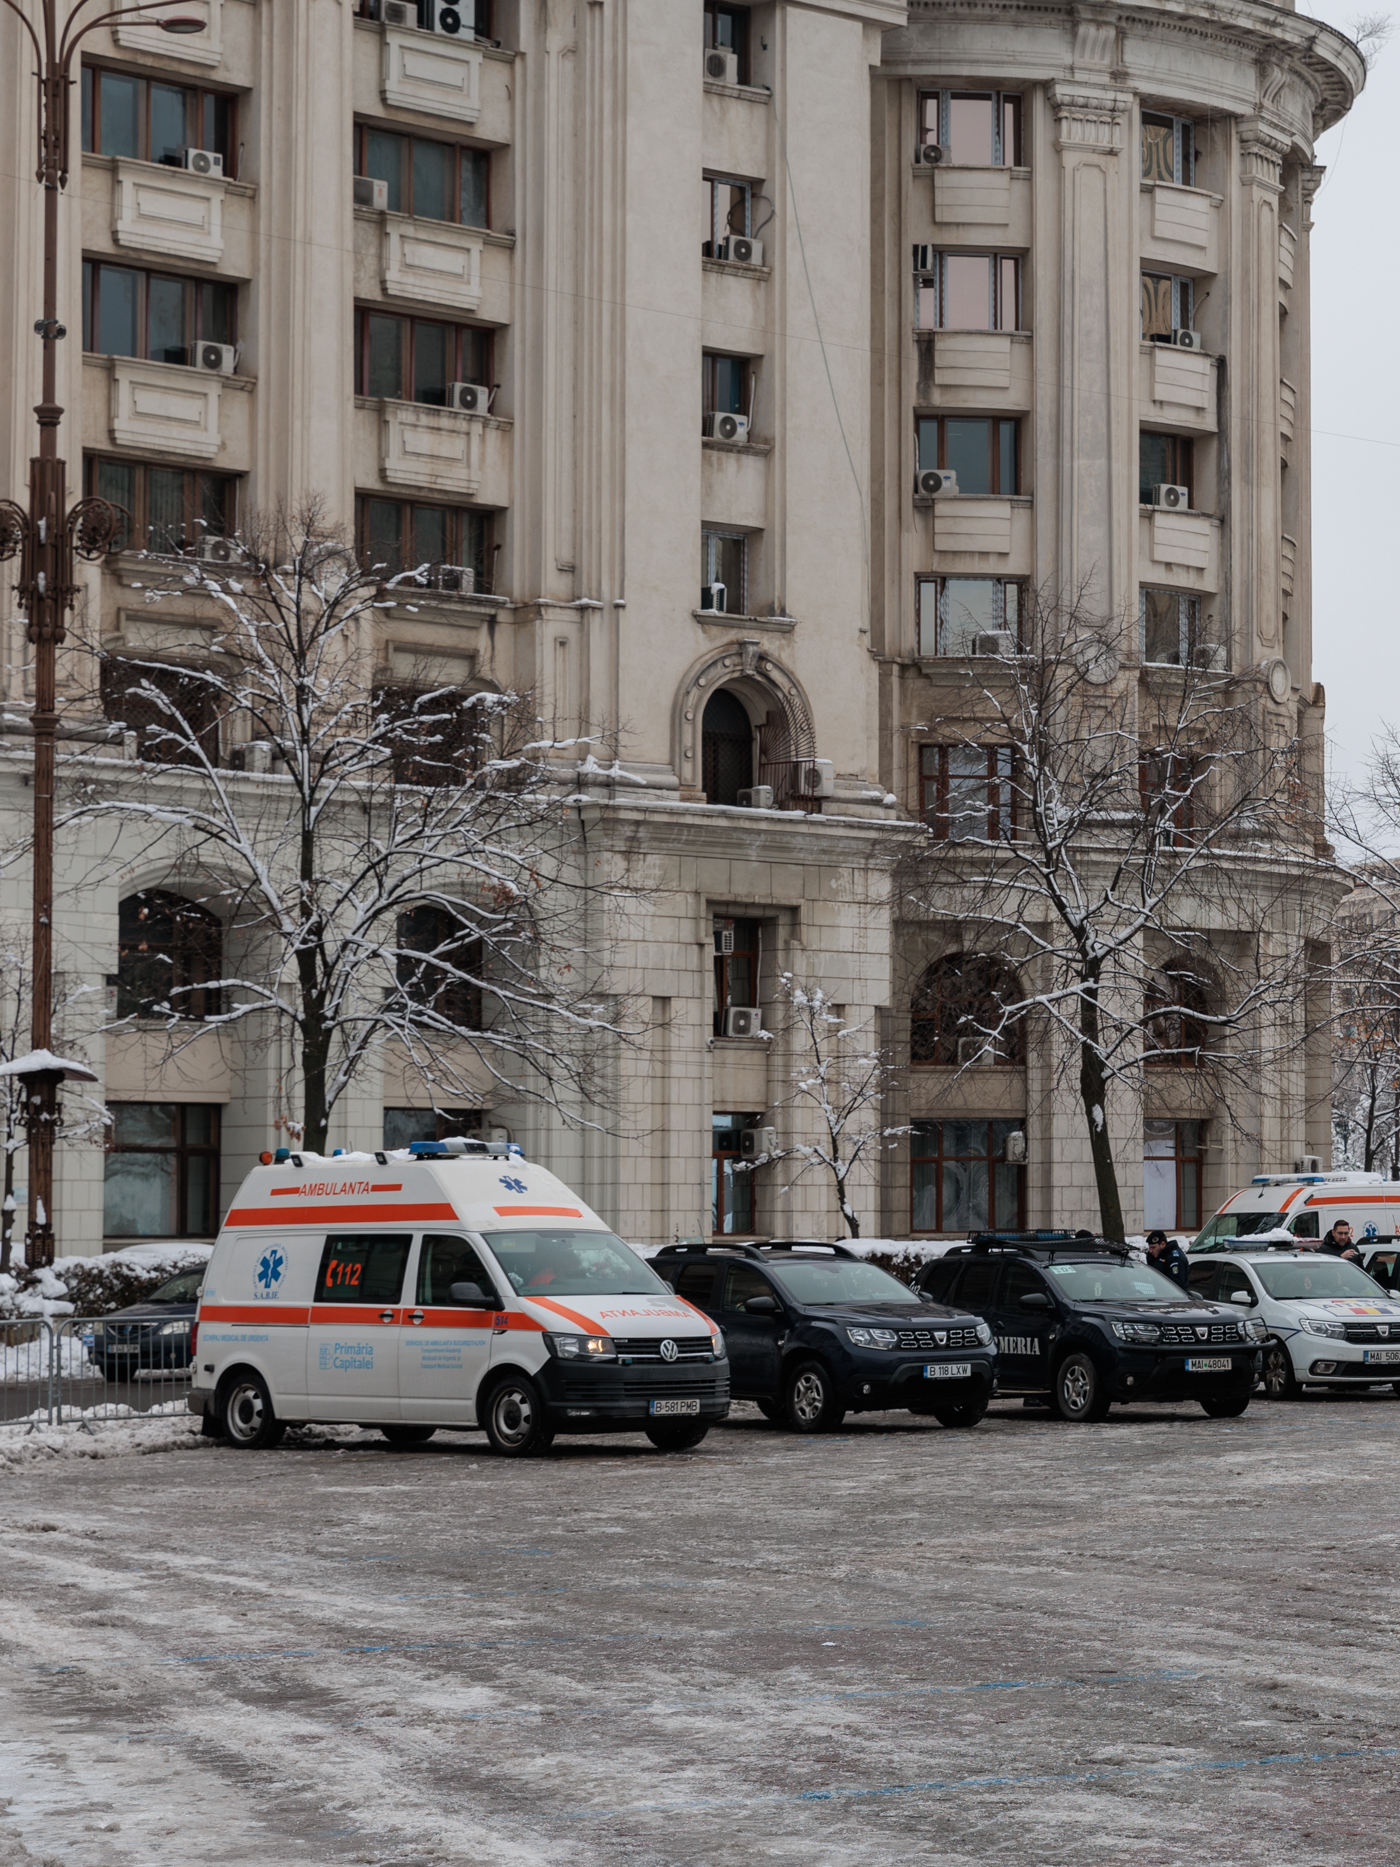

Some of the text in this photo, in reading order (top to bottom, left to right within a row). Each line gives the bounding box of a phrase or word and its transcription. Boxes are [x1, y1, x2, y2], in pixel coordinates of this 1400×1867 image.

[298, 1181, 370, 1197] AMBULANTA
[336, 1263, 362, 1285] 112
[495, 1316, 508, 1326] 514
[334, 1342, 374, 1355] Primăria
[1370, 1352, 1382, 1361] MAI
[333, 1357, 374, 1372] Capitalei
[1191, 1359, 1230, 1369] MAI 48041
[930, 1365, 968, 1376] B 118 LXW
[655, 1400, 698, 1412] B 581 PMB
